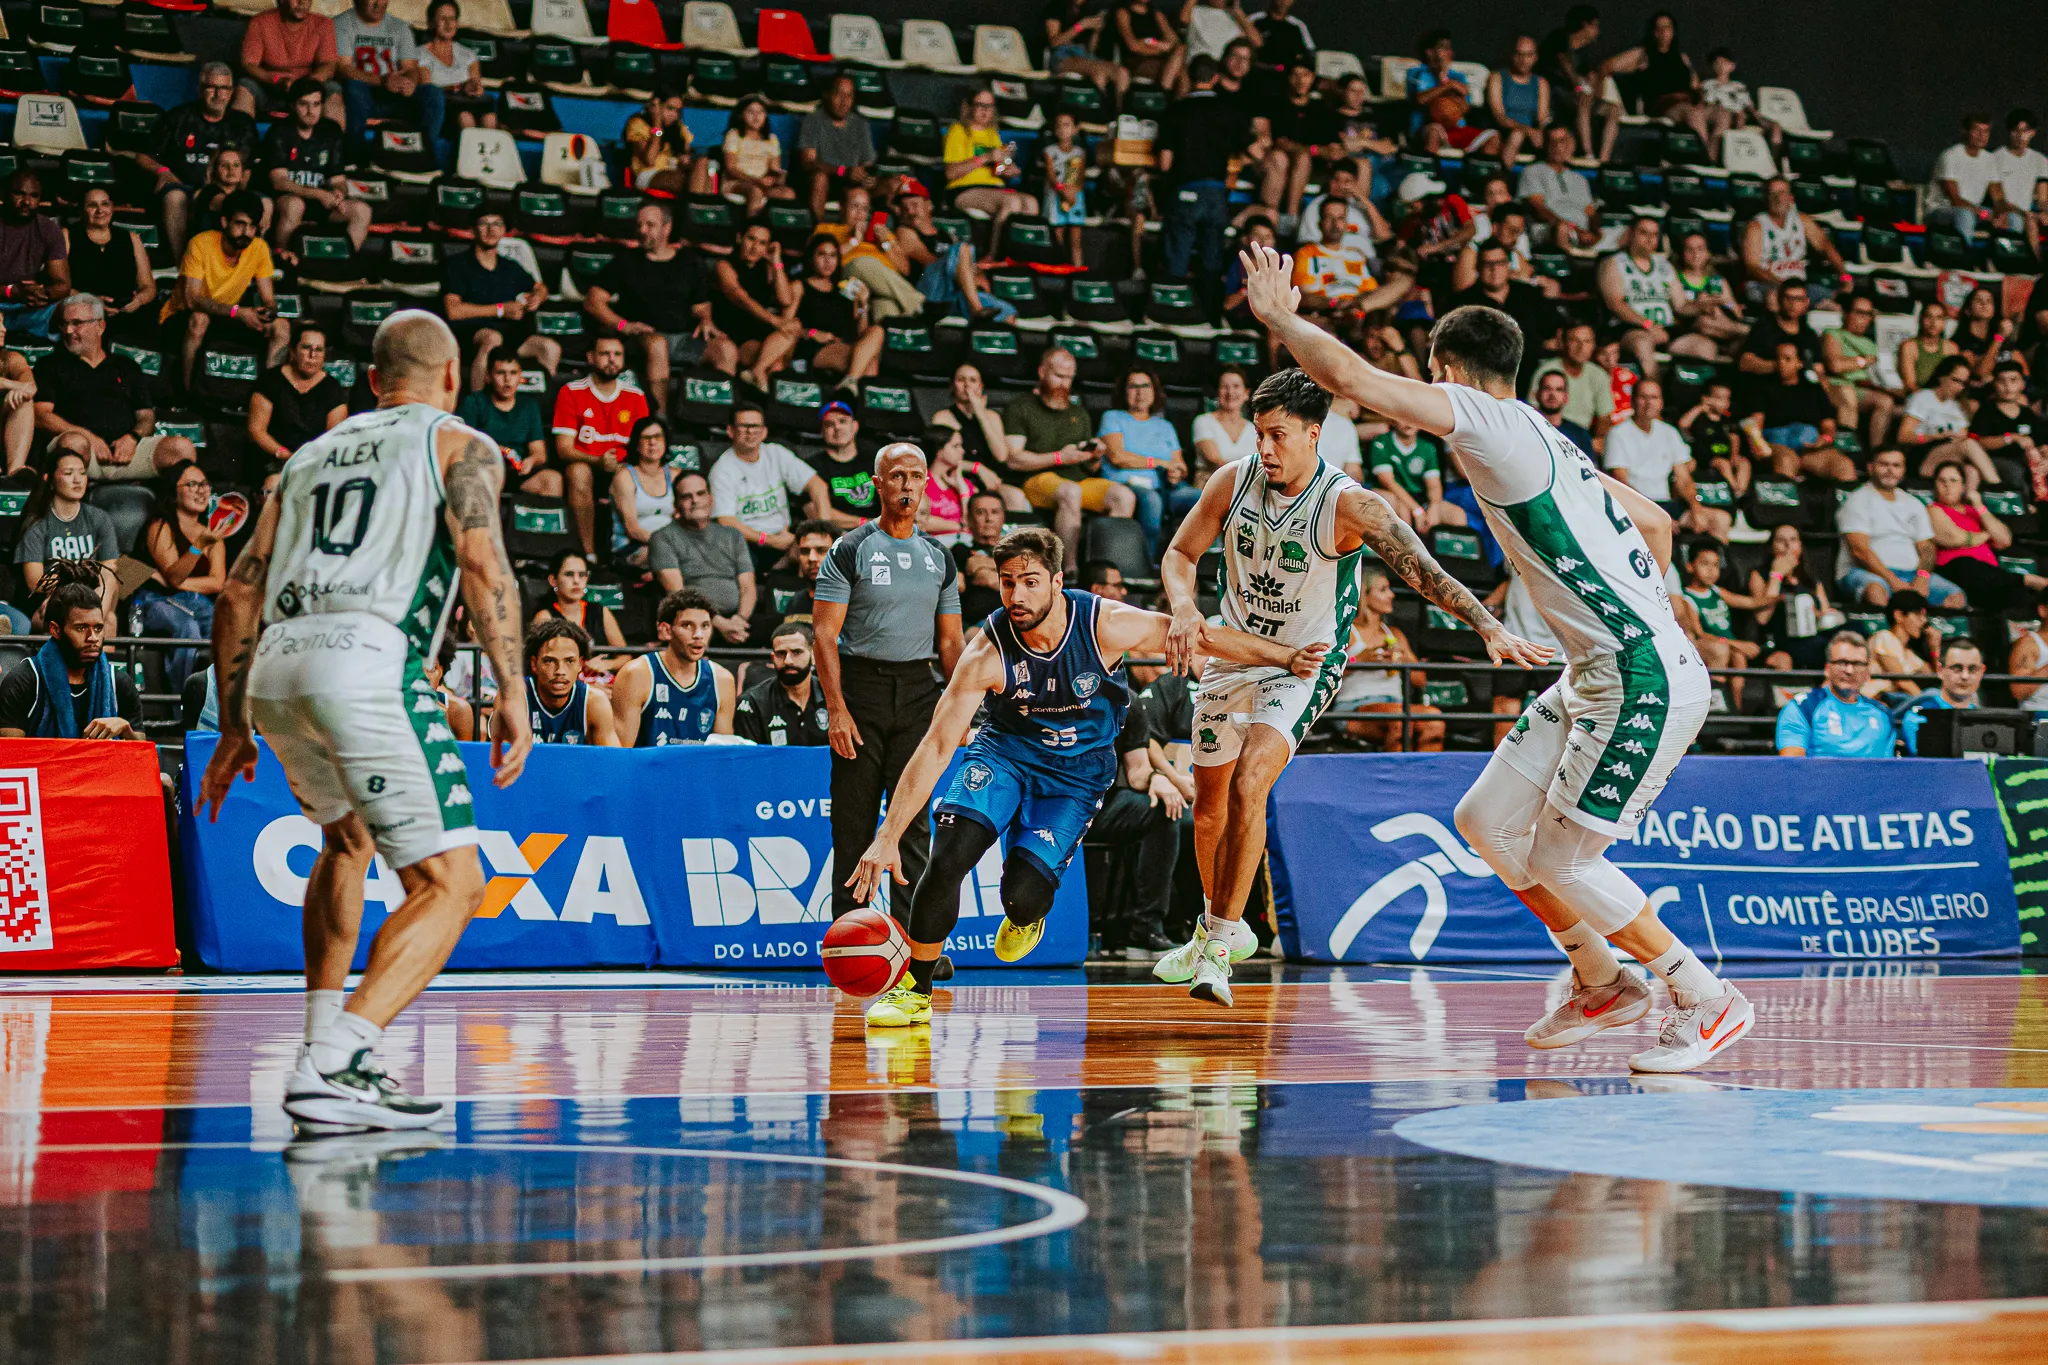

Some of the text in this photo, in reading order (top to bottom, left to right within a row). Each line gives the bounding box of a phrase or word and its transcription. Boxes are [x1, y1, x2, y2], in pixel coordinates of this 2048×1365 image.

[323, 440, 384, 468] ALEX
[311, 477, 377, 556] 10
[1279, 557, 1308, 571] BAURU
[1531, 701, 1560, 724] CORP
[1041, 726, 1078, 747] 35
[1751, 814, 1804, 852] DE
[1811, 810, 1974, 852] ATLETAS
[253, 814, 652, 926] CXA
[1728, 889, 1989, 926] COMITÊ BRASILEIRO
[714, 943, 744, 959] DO
[752, 940, 808, 958] LADO
[1802, 927, 1941, 957] DE CLUBES
